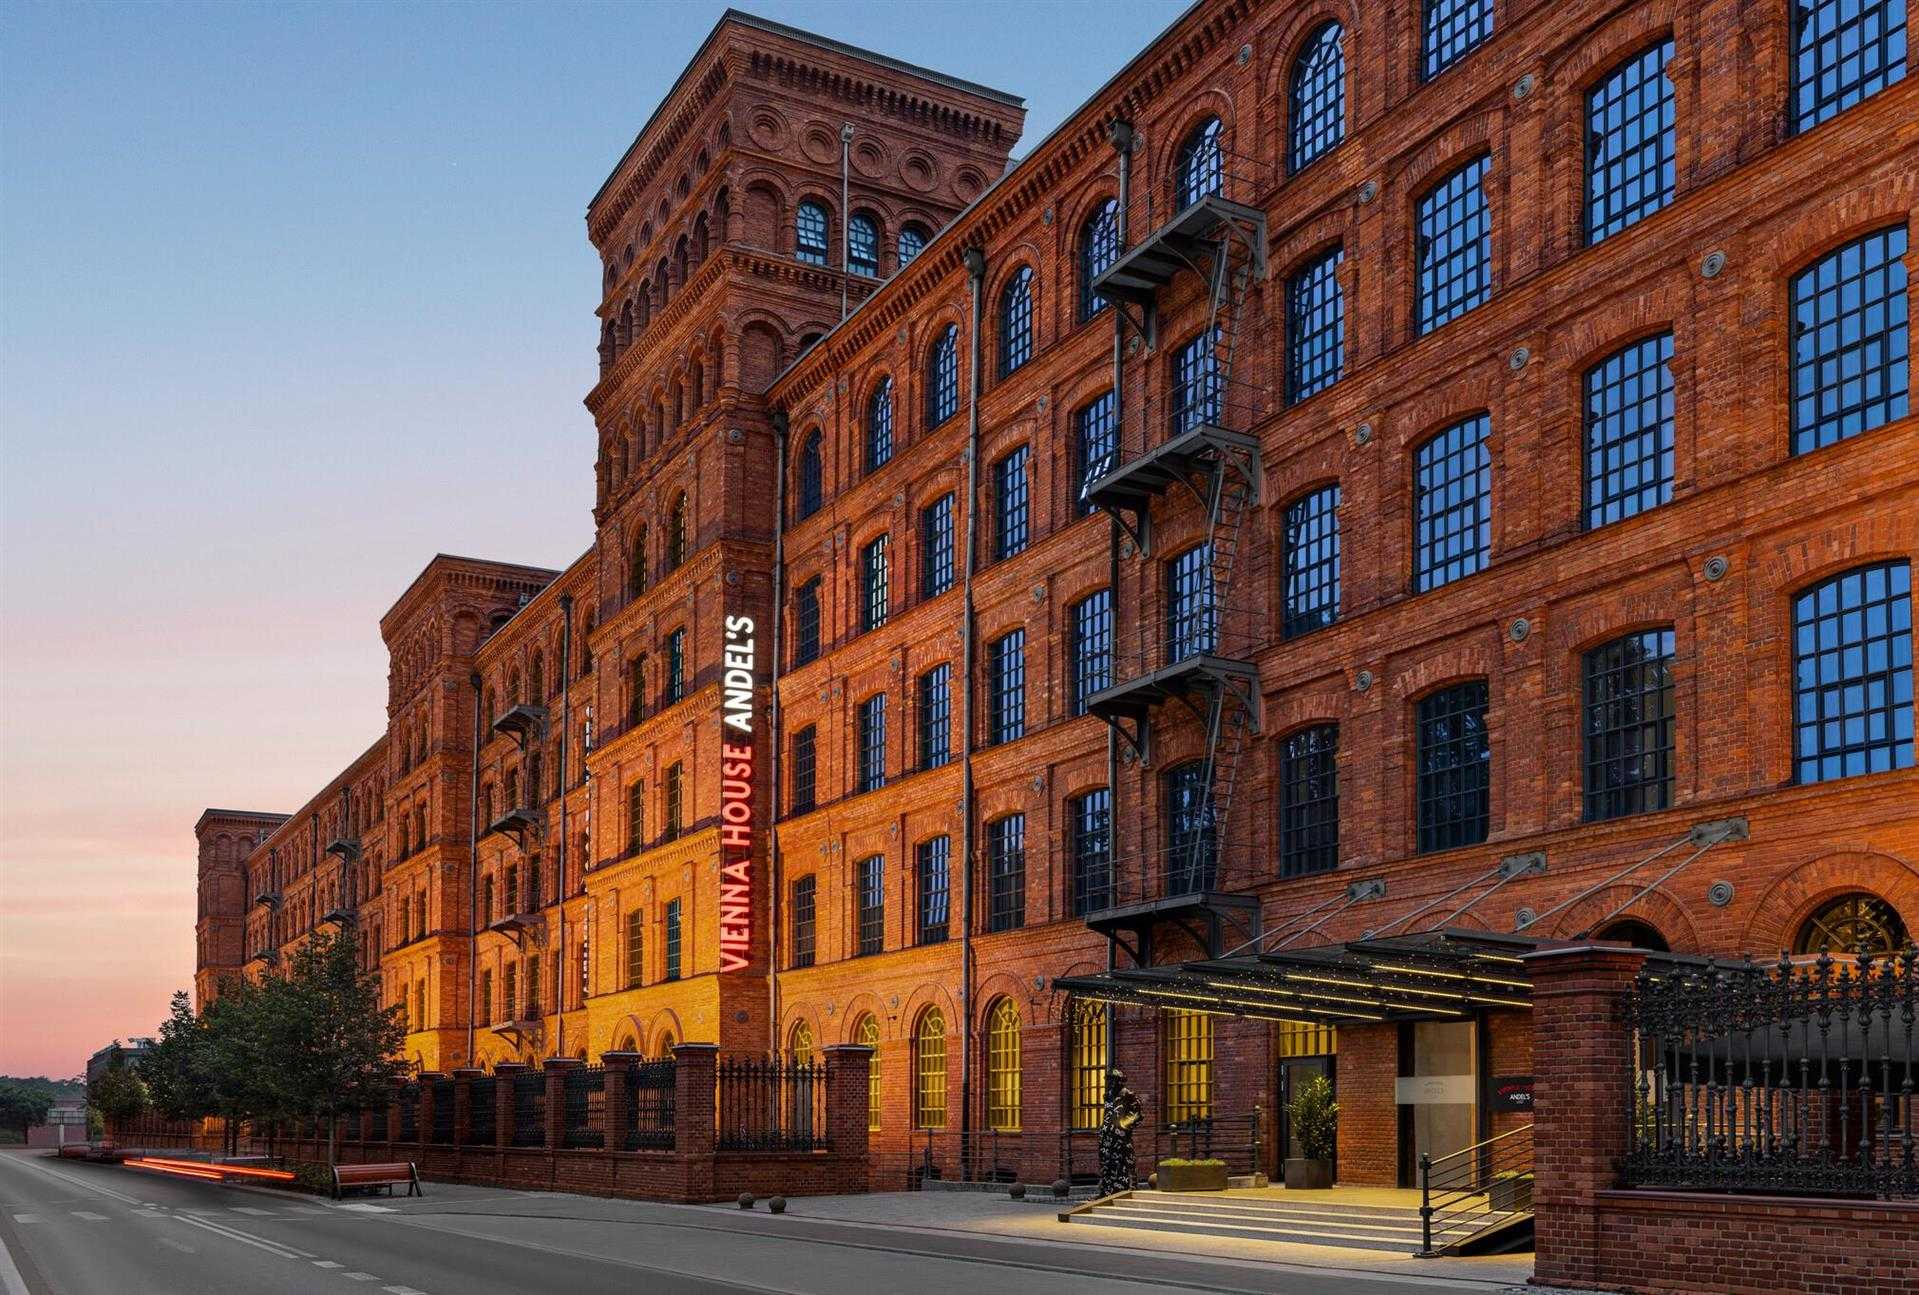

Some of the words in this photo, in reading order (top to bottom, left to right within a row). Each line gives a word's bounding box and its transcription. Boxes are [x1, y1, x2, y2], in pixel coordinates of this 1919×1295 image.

[723, 615, 754, 733] ANDEL'S
[721, 744, 752, 846] HOUSE
[720, 860, 750, 974] VIENNA
